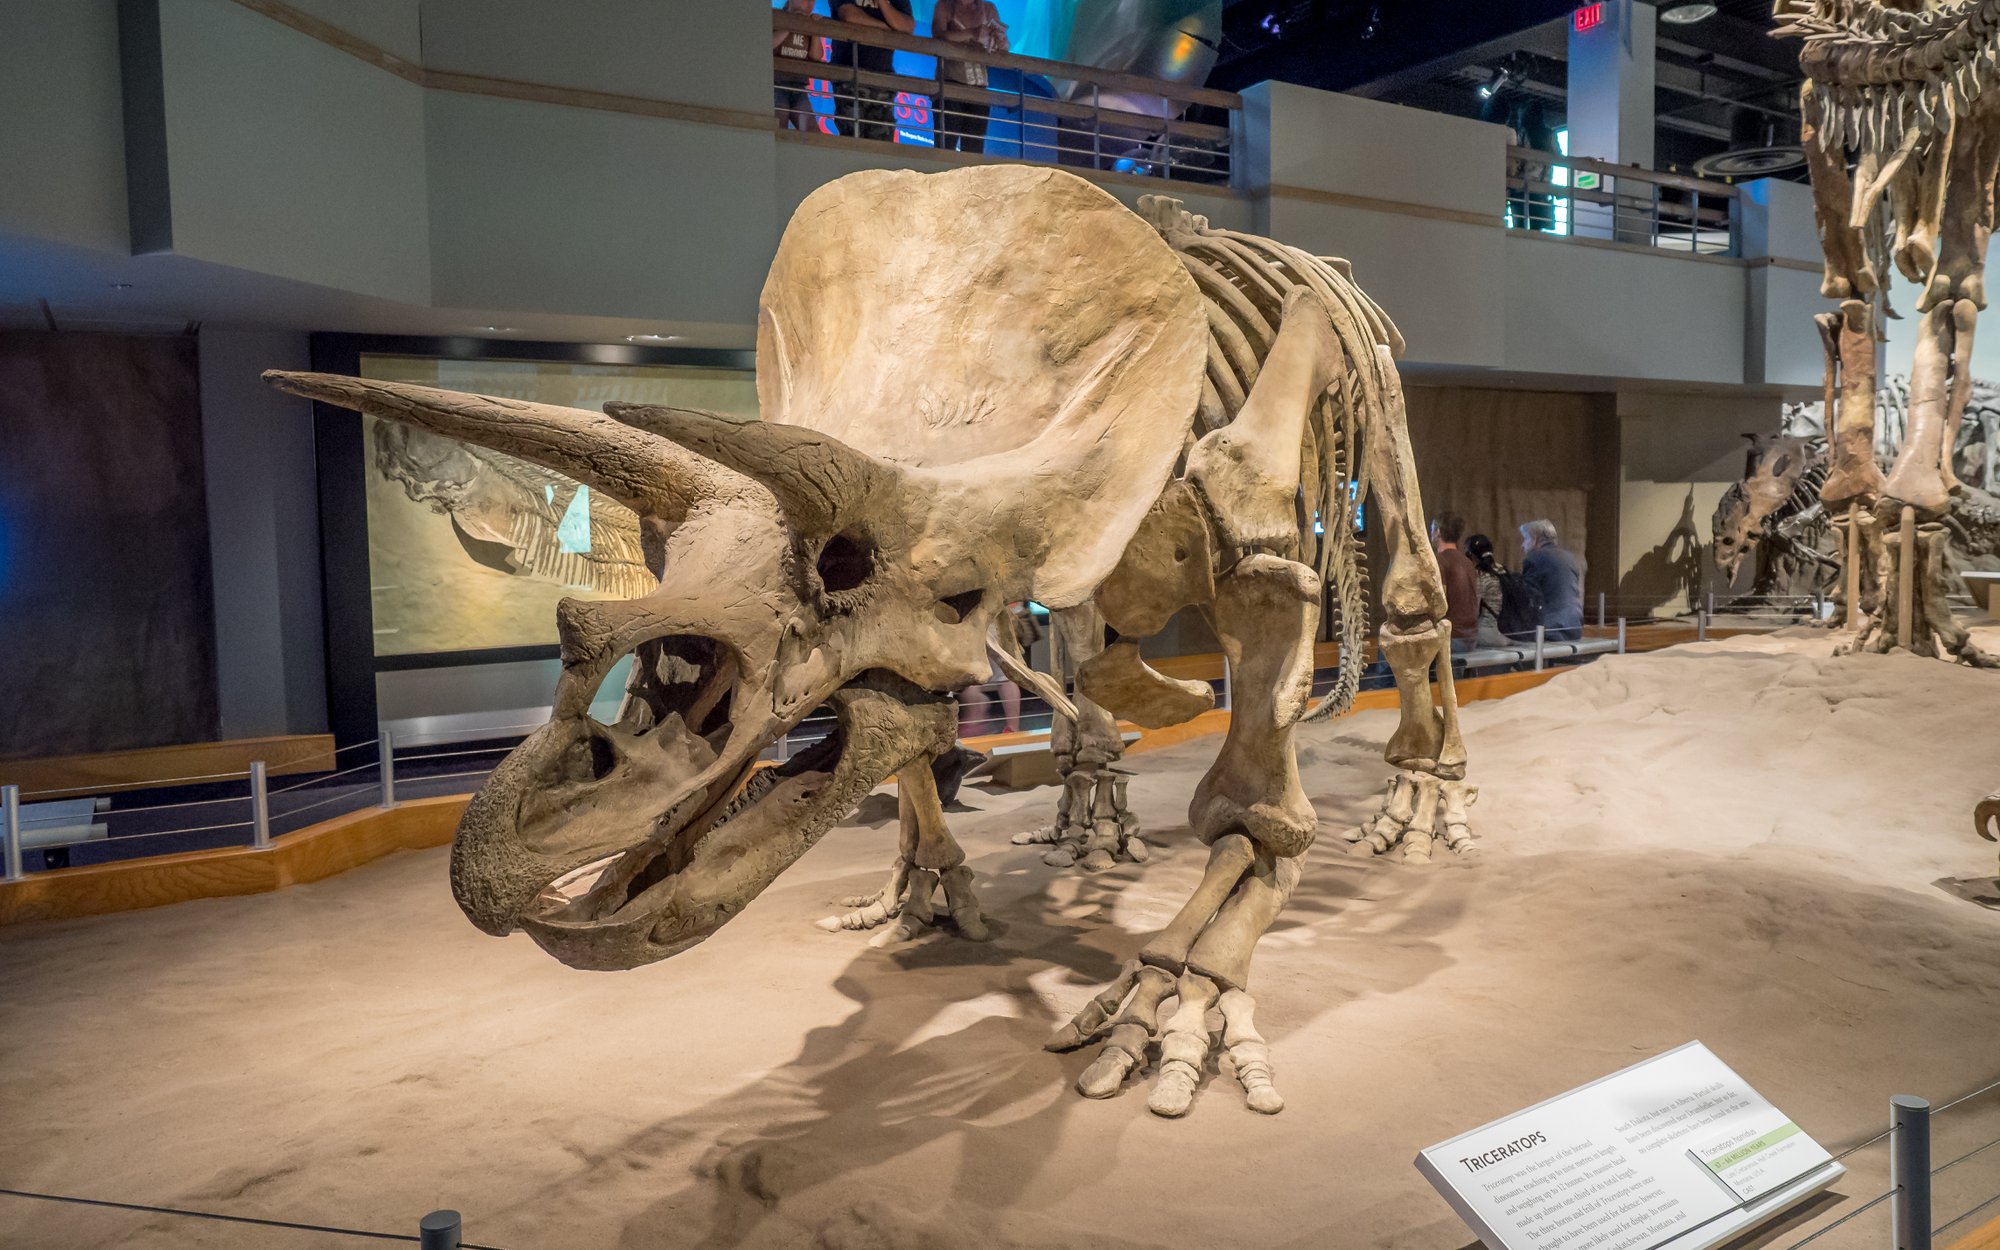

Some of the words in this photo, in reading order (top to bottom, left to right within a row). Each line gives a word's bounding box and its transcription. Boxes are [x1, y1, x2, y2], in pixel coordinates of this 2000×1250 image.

[1576, 3, 1600, 31] EXIT
[793, 34, 804, 46] ME
[1459, 1131, 1546, 1173] TRICERATOPS
[1700, 1139, 1735, 1158] Triceratops
[1730, 1129, 1757, 1143] horridus
[1730, 1148, 1752, 1160] MILLION
[1749, 1140, 1766, 1150] YEARS
[1481, 1175, 1516, 1192] Triceratops
[1534, 1156, 1557, 1168] largest
[1569, 1138, 1593, 1153] horned
[1493, 1188, 1525, 1204] dinosaurs,
[1523, 1176, 1550, 1191] reaching
[1561, 1164, 1576, 1173] nine
[1596, 1144, 1617, 1157] length
[1516, 1195, 1546, 1210] weighing
[1610, 1155, 1627, 1166] head
[1516, 1215, 1534, 1228] made
[1542, 1202, 1564, 1216] almost
[1603, 1175, 1619, 1186] total
[1614, 1167, 1638, 1181] length.
[1539, 1224, 1557, 1234] three
[1552, 1215, 1574, 1227] horns
[1581, 1202, 1596, 1213] frill
[1599, 1188, 1631, 1205] Triceratops
[1629, 1182, 1643, 1191] were
[1641, 1176, 1656, 1185] once
[1742, 1184, 1756, 1194] CAST
[1538, 1237, 1564, 1250] thought
[1566, 1228, 1584, 1238] have
[1580, 1221, 1599, 1231] been
[1596, 1212, 1613, 1224] used
[1578, 1241, 1595, 1250] more
[1590, 1232, 1611, 1245] likely
[1608, 1224, 1624, 1236] used
[1657, 1198, 1679, 1212] remains
[1646, 1218, 1677, 1235] Montana,
